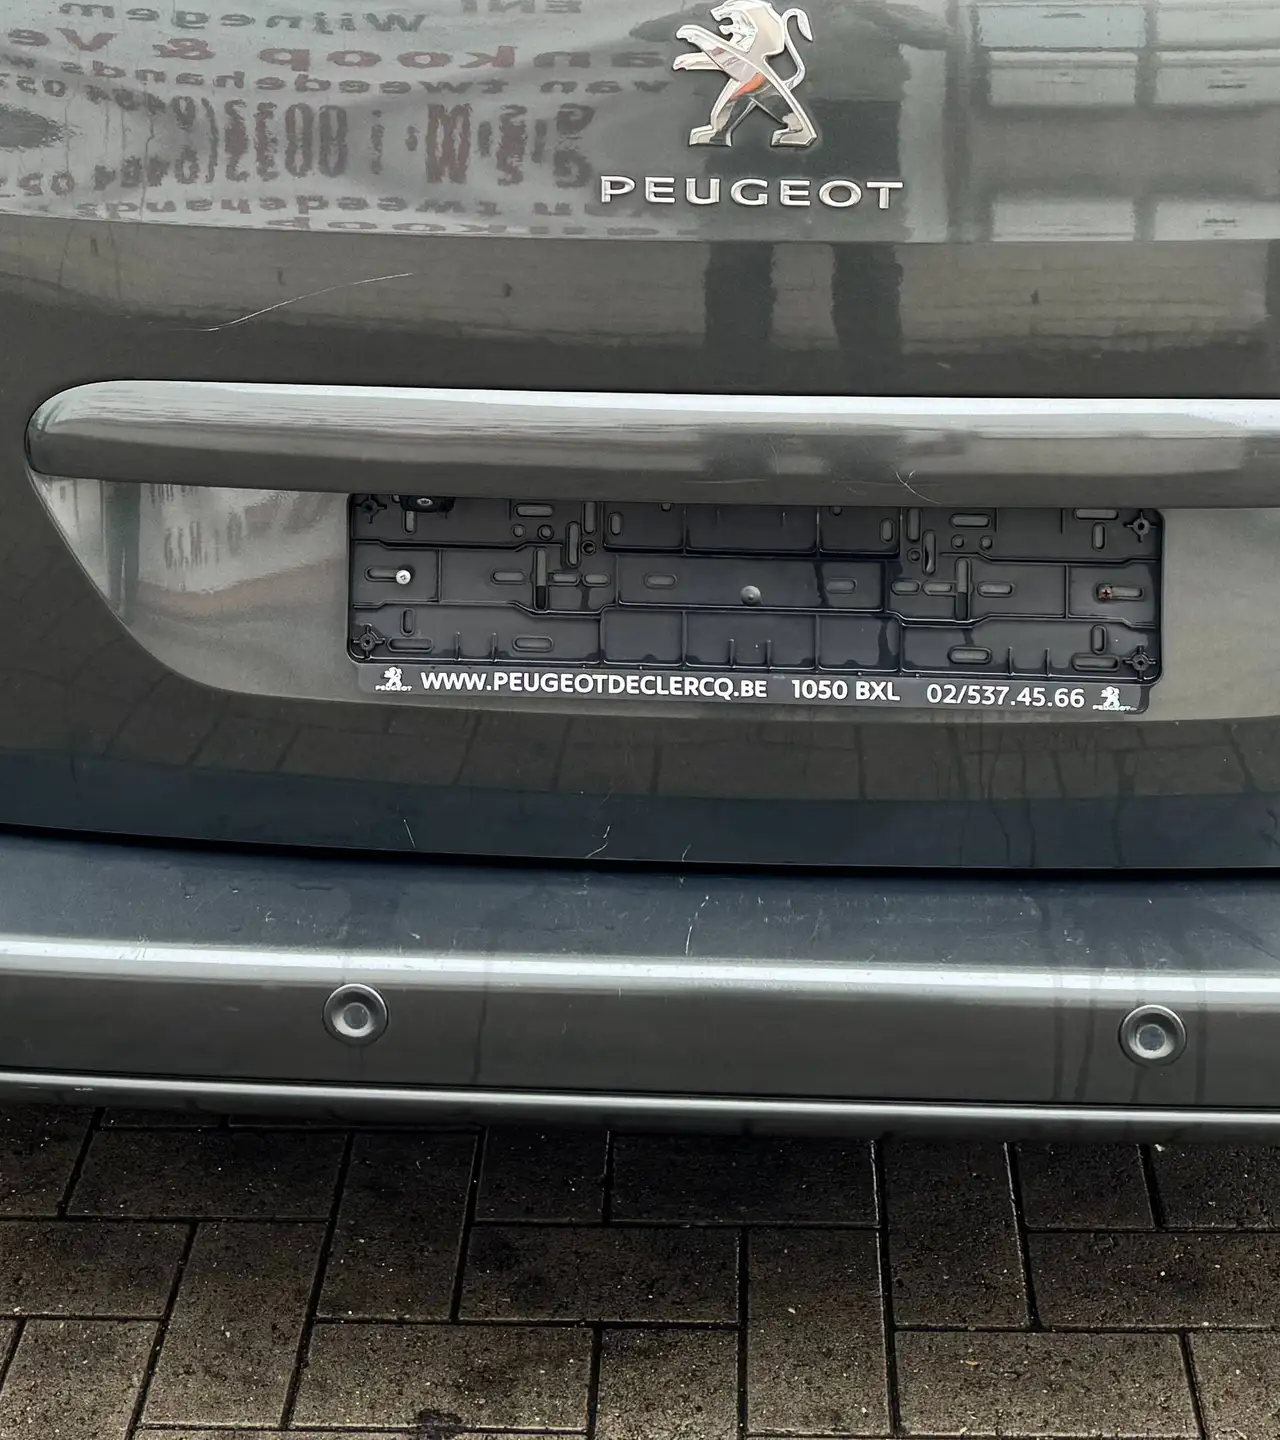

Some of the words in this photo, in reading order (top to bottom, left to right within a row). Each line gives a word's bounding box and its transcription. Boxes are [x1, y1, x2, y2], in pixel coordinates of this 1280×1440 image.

[600, 175, 904, 209] PEUGEOT
[420, 671, 769, 701] WWW.PEUGEOTDECLERCQ.BE
[792, 678, 849, 701] 1050
[854, 680, 901, 702] BXL
[926, 683, 1086, 709] 02/537.45.66
